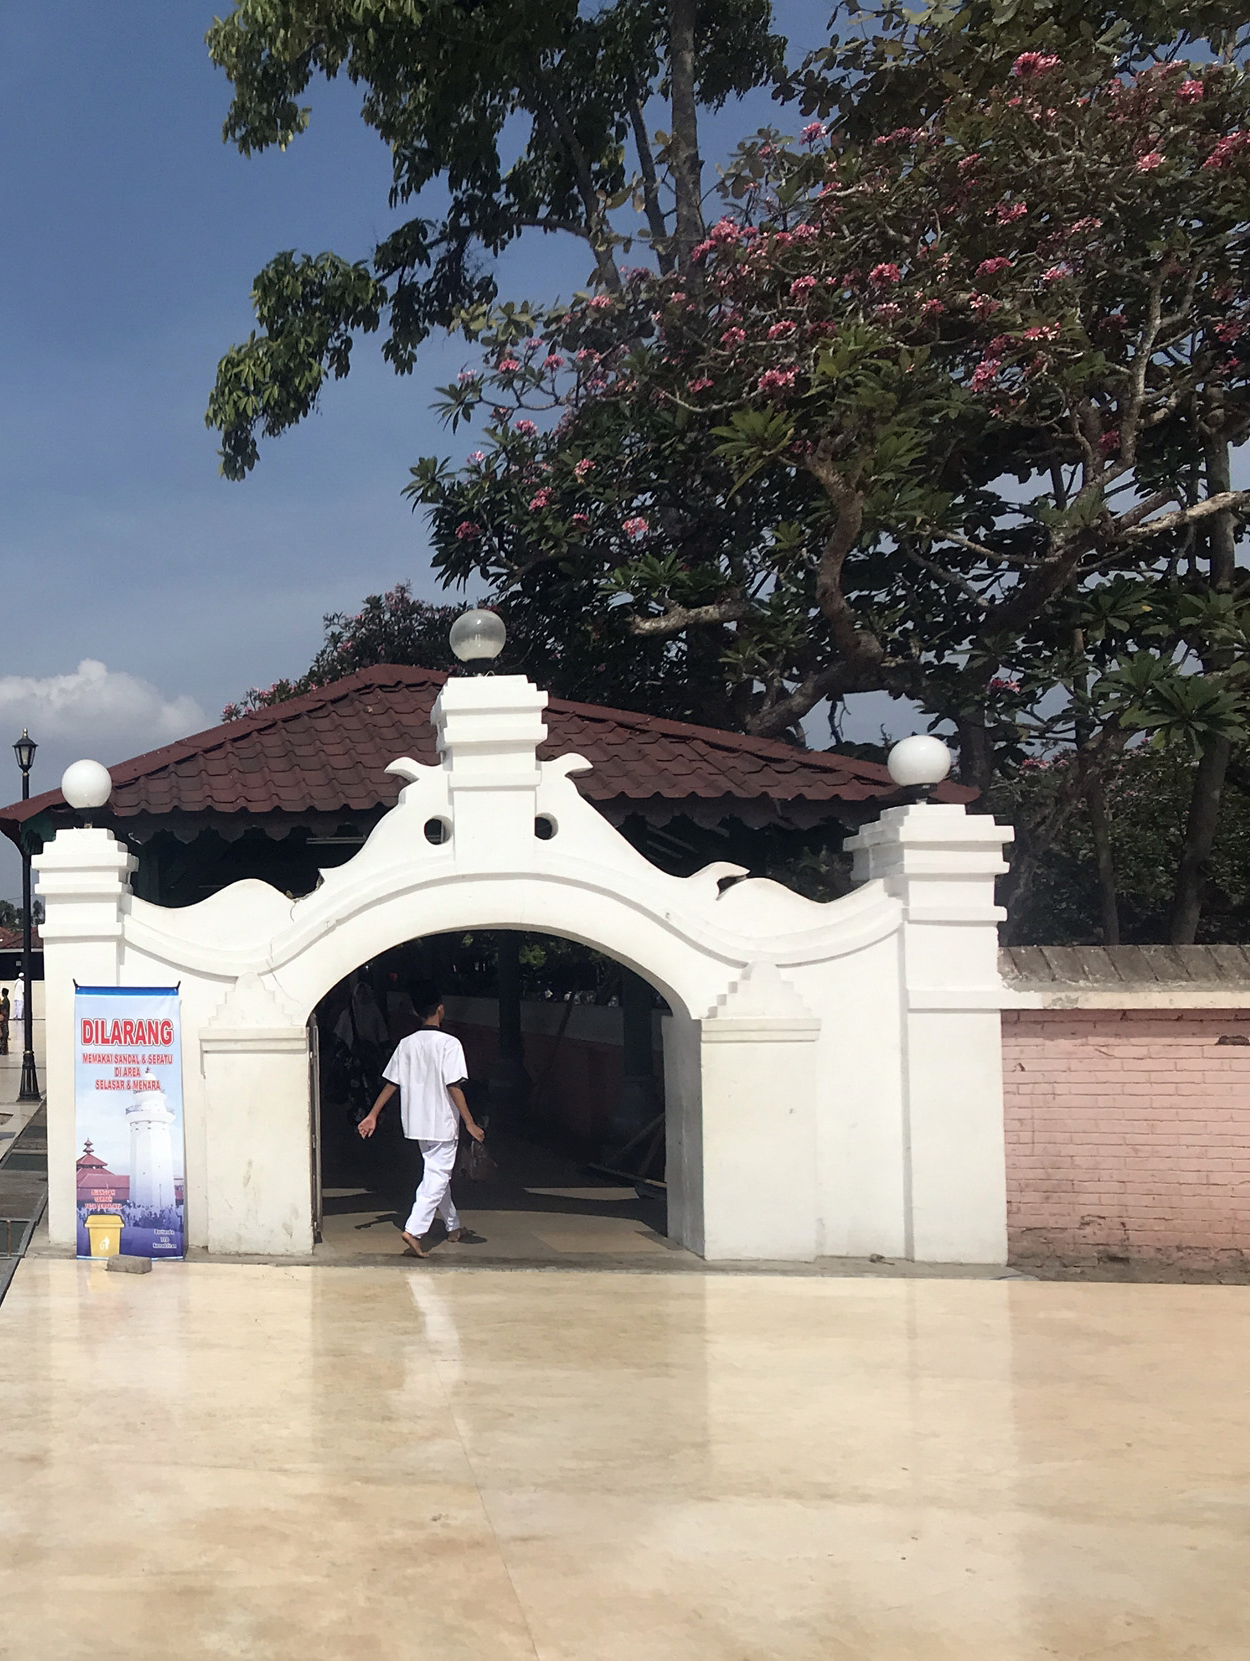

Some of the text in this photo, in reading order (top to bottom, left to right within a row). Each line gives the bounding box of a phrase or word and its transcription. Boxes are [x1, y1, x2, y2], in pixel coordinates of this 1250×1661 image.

[82, 1019, 173, 1046] DILARANG
[82, 1053, 113, 1064] MEMAKAI
[114, 1053, 139, 1064] SANDAL
[148, 1054, 173, 1065] SEPATU
[114, 1067, 141, 1077] DI AREA
[95, 1080, 125, 1090] SELASAR
[133, 1080, 161, 1090] MENARA
